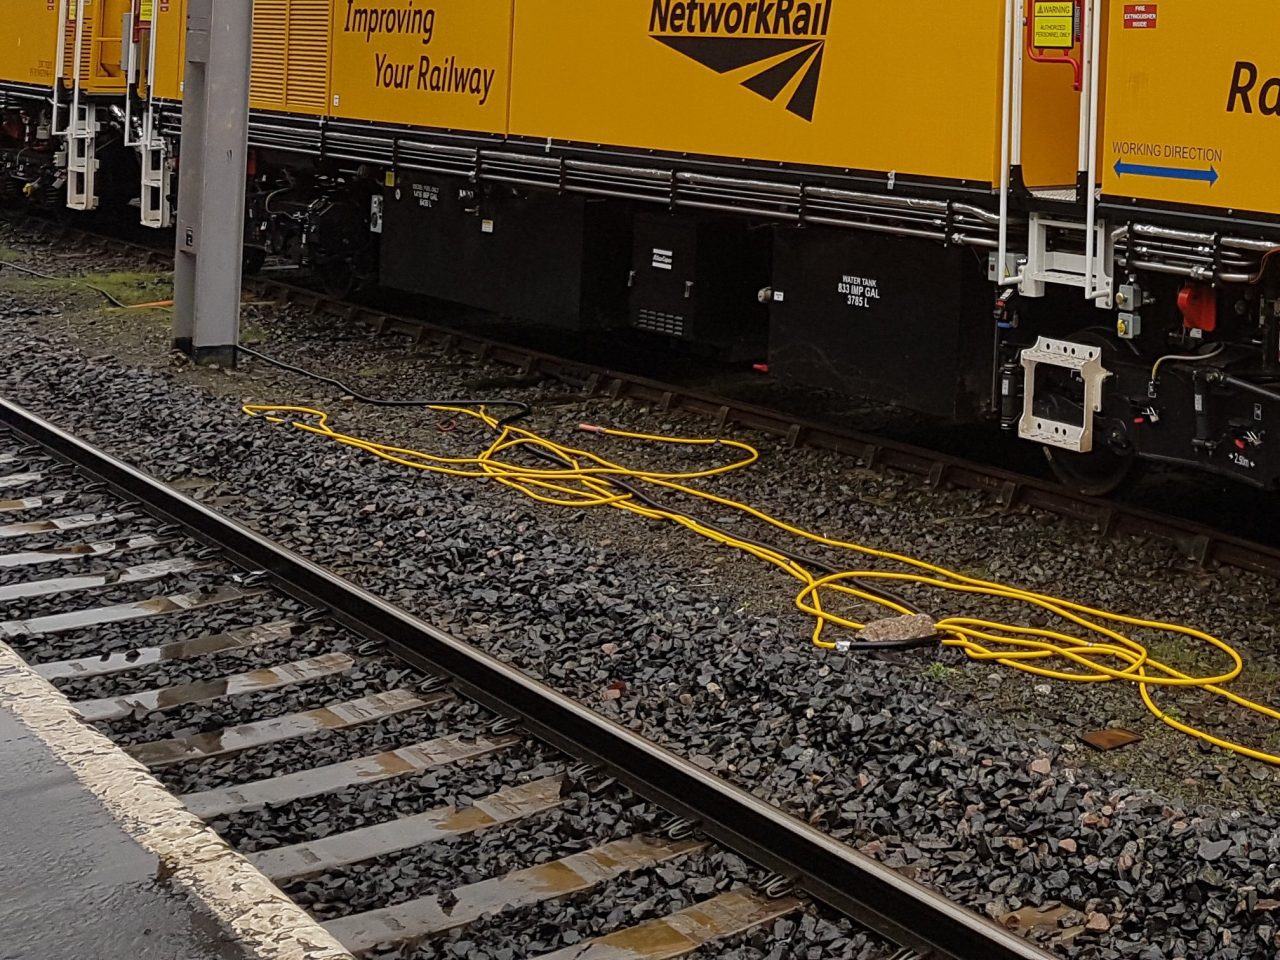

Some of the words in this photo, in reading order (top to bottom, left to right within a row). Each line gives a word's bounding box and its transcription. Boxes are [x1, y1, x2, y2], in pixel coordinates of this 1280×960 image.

[1043, 5, 1071, 14] WARNING
[344, 0, 436, 45] Improving
[375, 53, 415, 90] Your
[416, 55, 496, 106] Railway
[1112, 141, 1161, 157] WORKING
[1163, 145, 1222, 162] DIRECTION
[842, 275, 861, 285] WATER
[861, 278, 877, 287] TANK
[837, 282, 850, 294] 833
[850, 285, 864, 295] IMP
[864, 287, 880, 299] GAL
[847, 295, 863, 307] 3785
[864, 297, 870, 308] L
